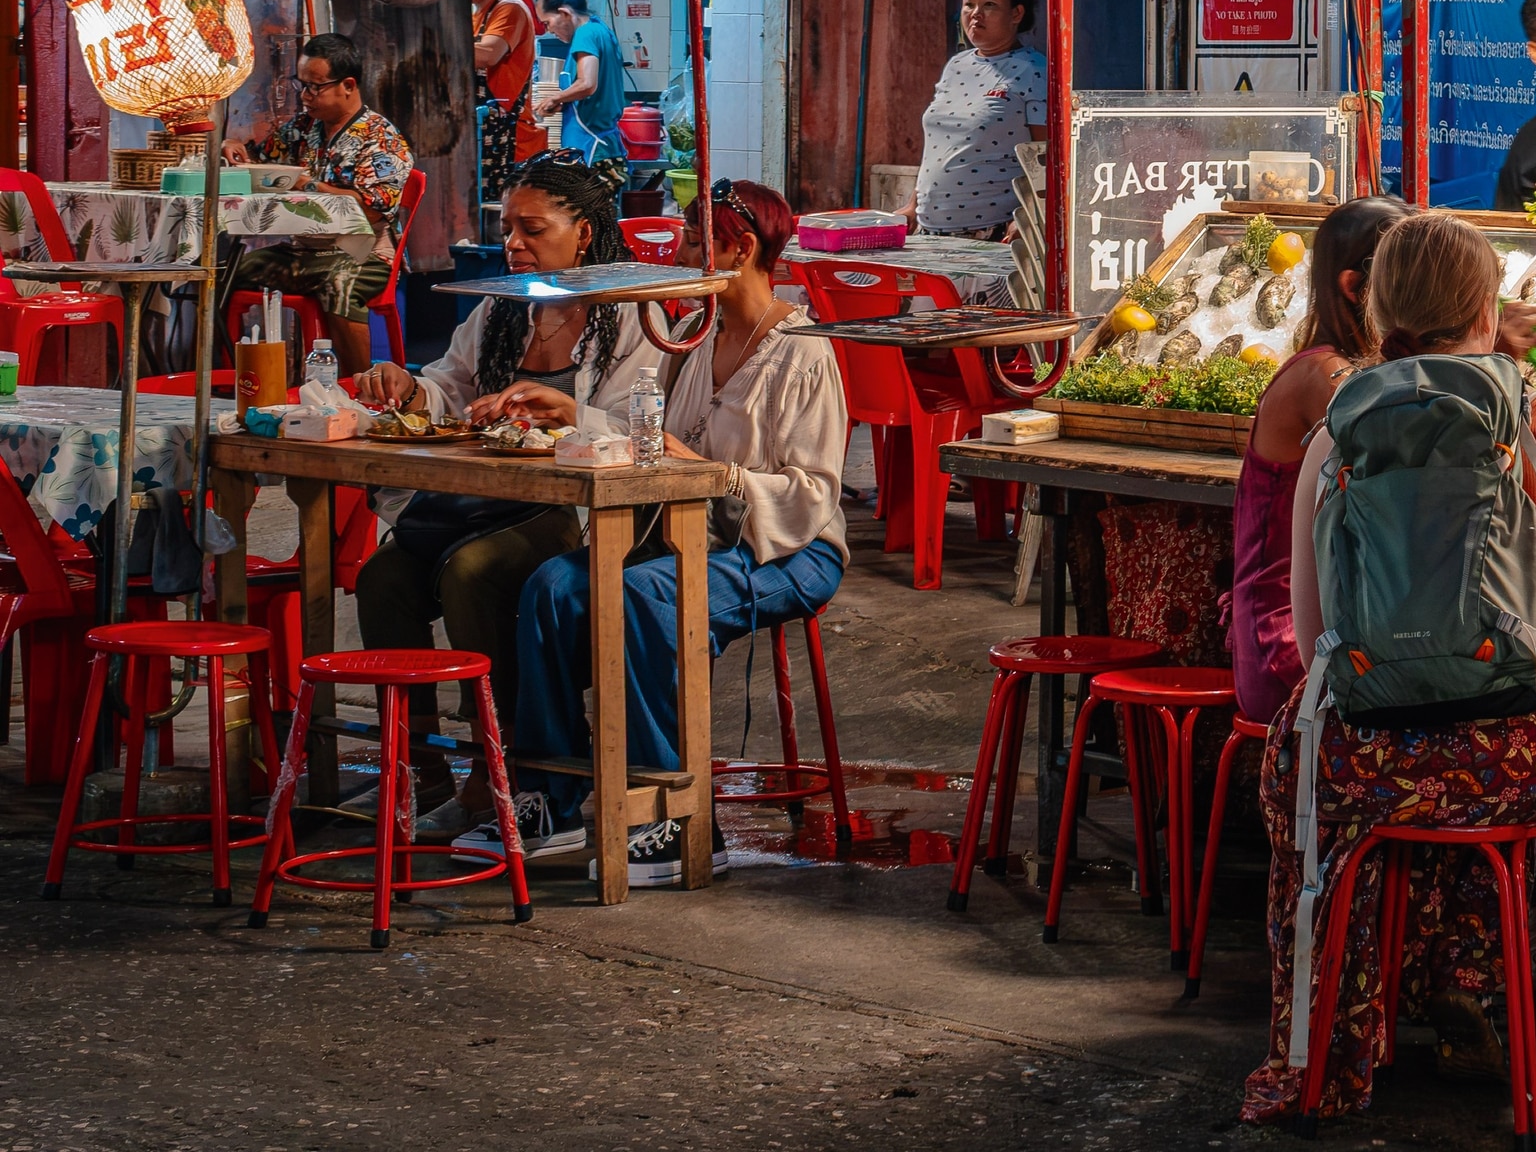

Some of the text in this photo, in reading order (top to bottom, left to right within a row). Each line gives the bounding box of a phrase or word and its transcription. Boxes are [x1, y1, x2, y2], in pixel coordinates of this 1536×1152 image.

[1216, 10, 1278, 20] NO TAKE A PHOTO
